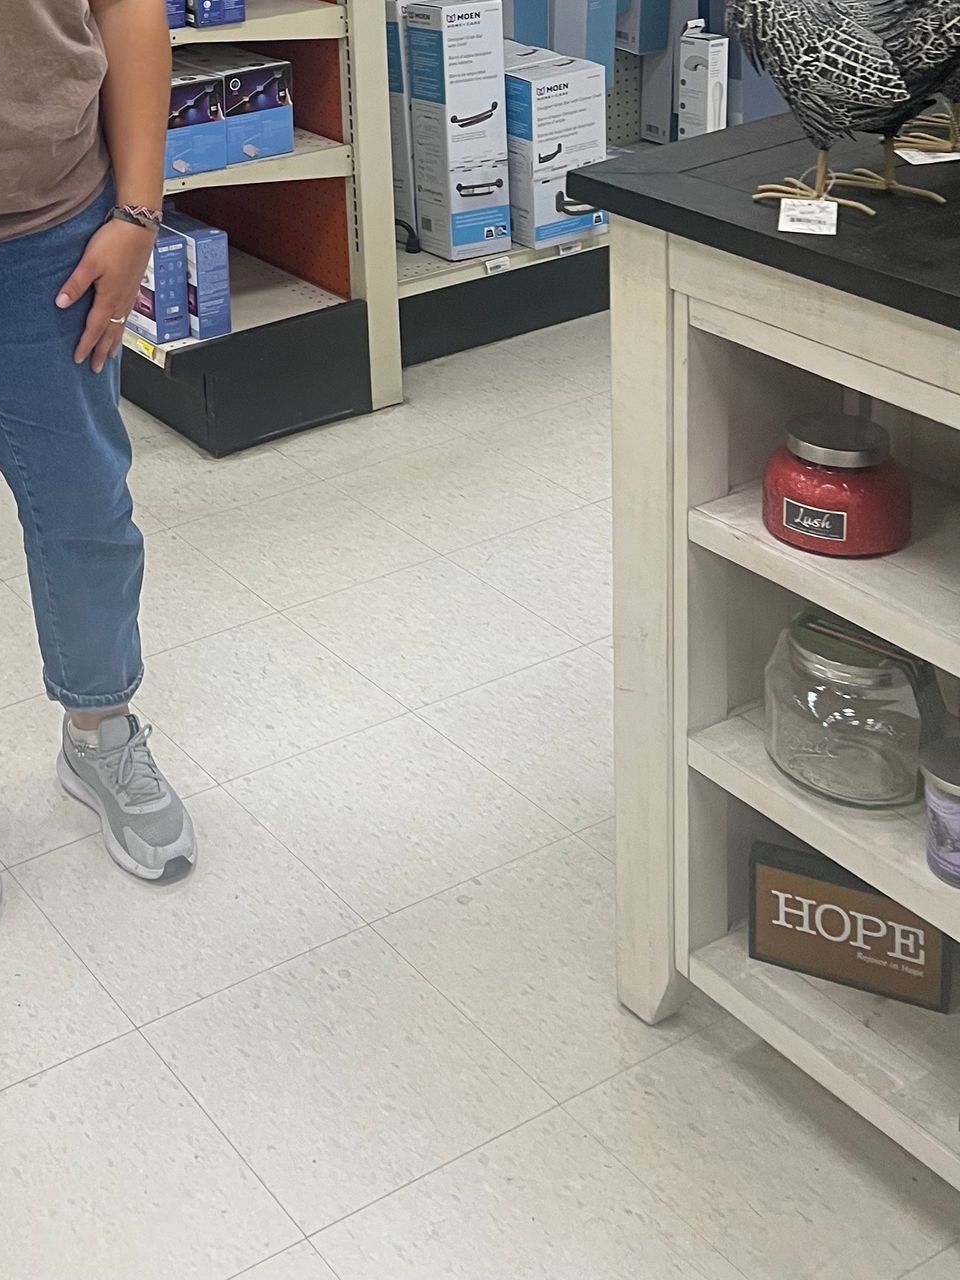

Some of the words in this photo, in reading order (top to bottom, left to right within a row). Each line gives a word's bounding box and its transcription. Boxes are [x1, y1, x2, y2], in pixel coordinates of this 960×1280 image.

[457, 11, 481, 21] MOEN
[546, 82, 569, 93] MOEN
[794, 508, 832, 529] Lush
[771, 889, 925, 966] HOPE
[856, 951, 887, 968] Rejoice
[890, 961, 899, 970] in
[901, 964, 924, 977] Hope
